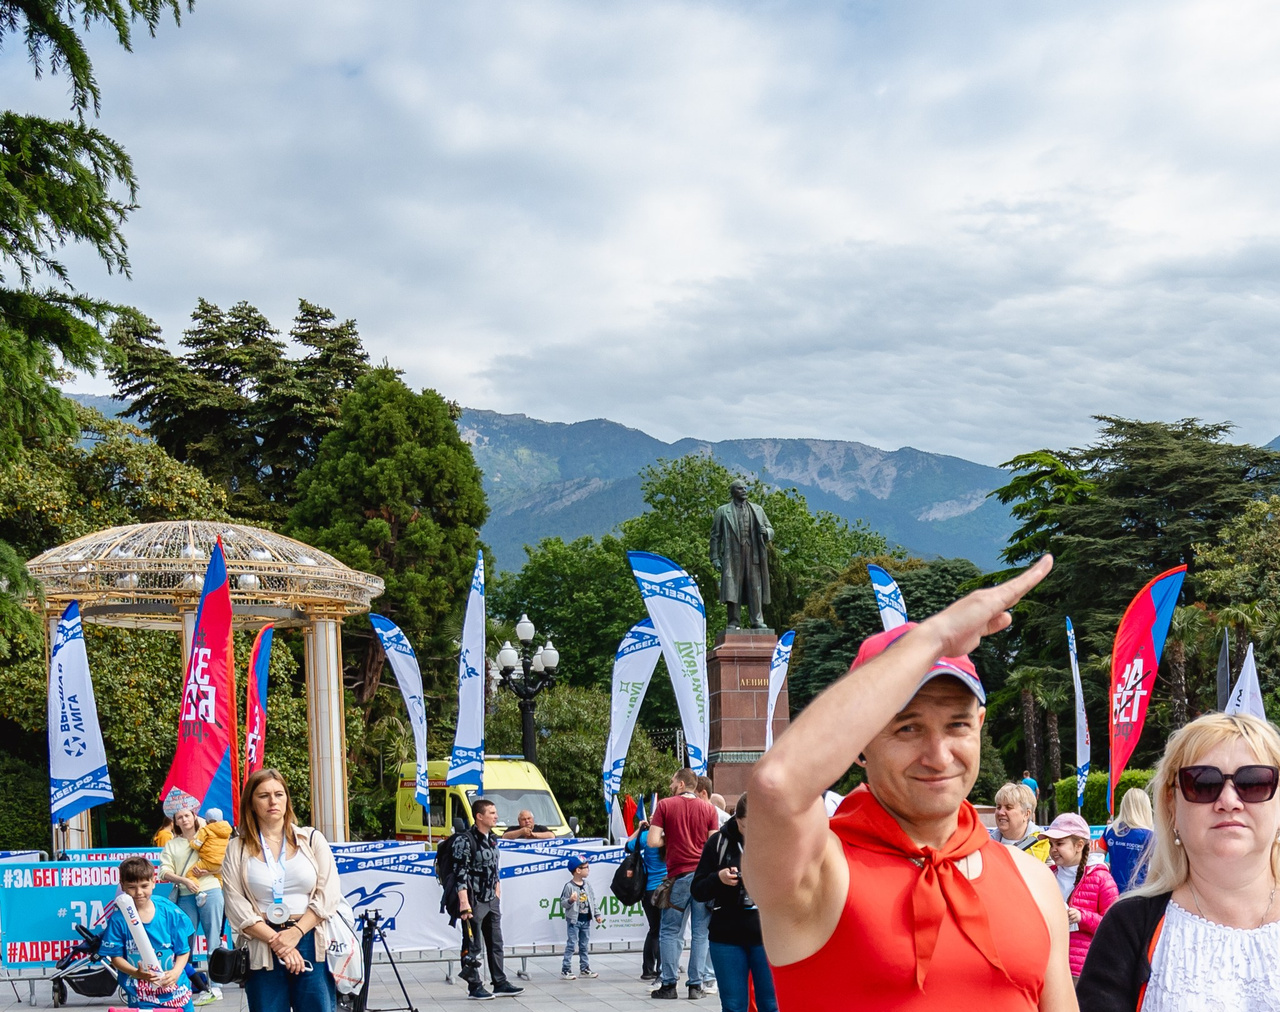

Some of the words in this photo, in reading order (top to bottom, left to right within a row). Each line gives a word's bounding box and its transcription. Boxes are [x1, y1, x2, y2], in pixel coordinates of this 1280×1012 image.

[740, 679, 769, 687] ЛЕНИН
[67, 694, 85, 733] ЛИГА
[357, 853, 419, 870] ЗАБЕГ.РФ
[590, 850, 630, 862] ЗАБЕГ.
[3, 868, 59, 889] #ЗАБЕГ
[61, 866, 121, 887] #СВОБО
